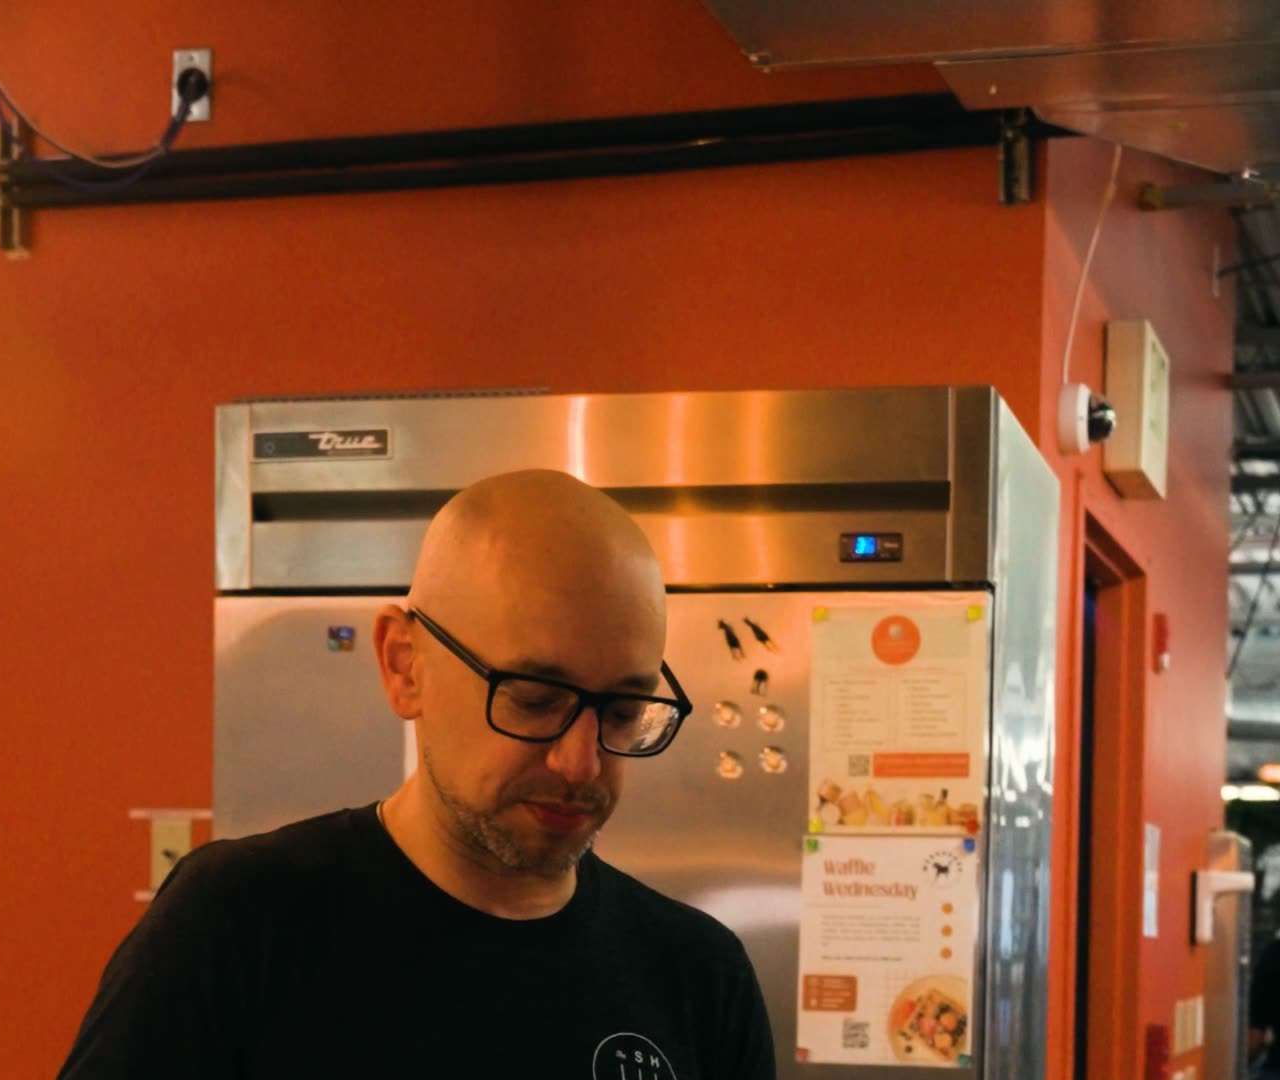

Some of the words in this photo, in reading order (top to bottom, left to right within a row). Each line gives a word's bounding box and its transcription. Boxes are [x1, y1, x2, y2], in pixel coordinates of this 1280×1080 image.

[308, 432, 383, 450] True
[823, 857, 875, 876] Waffle
[822, 881, 918, 900] Wednesday
